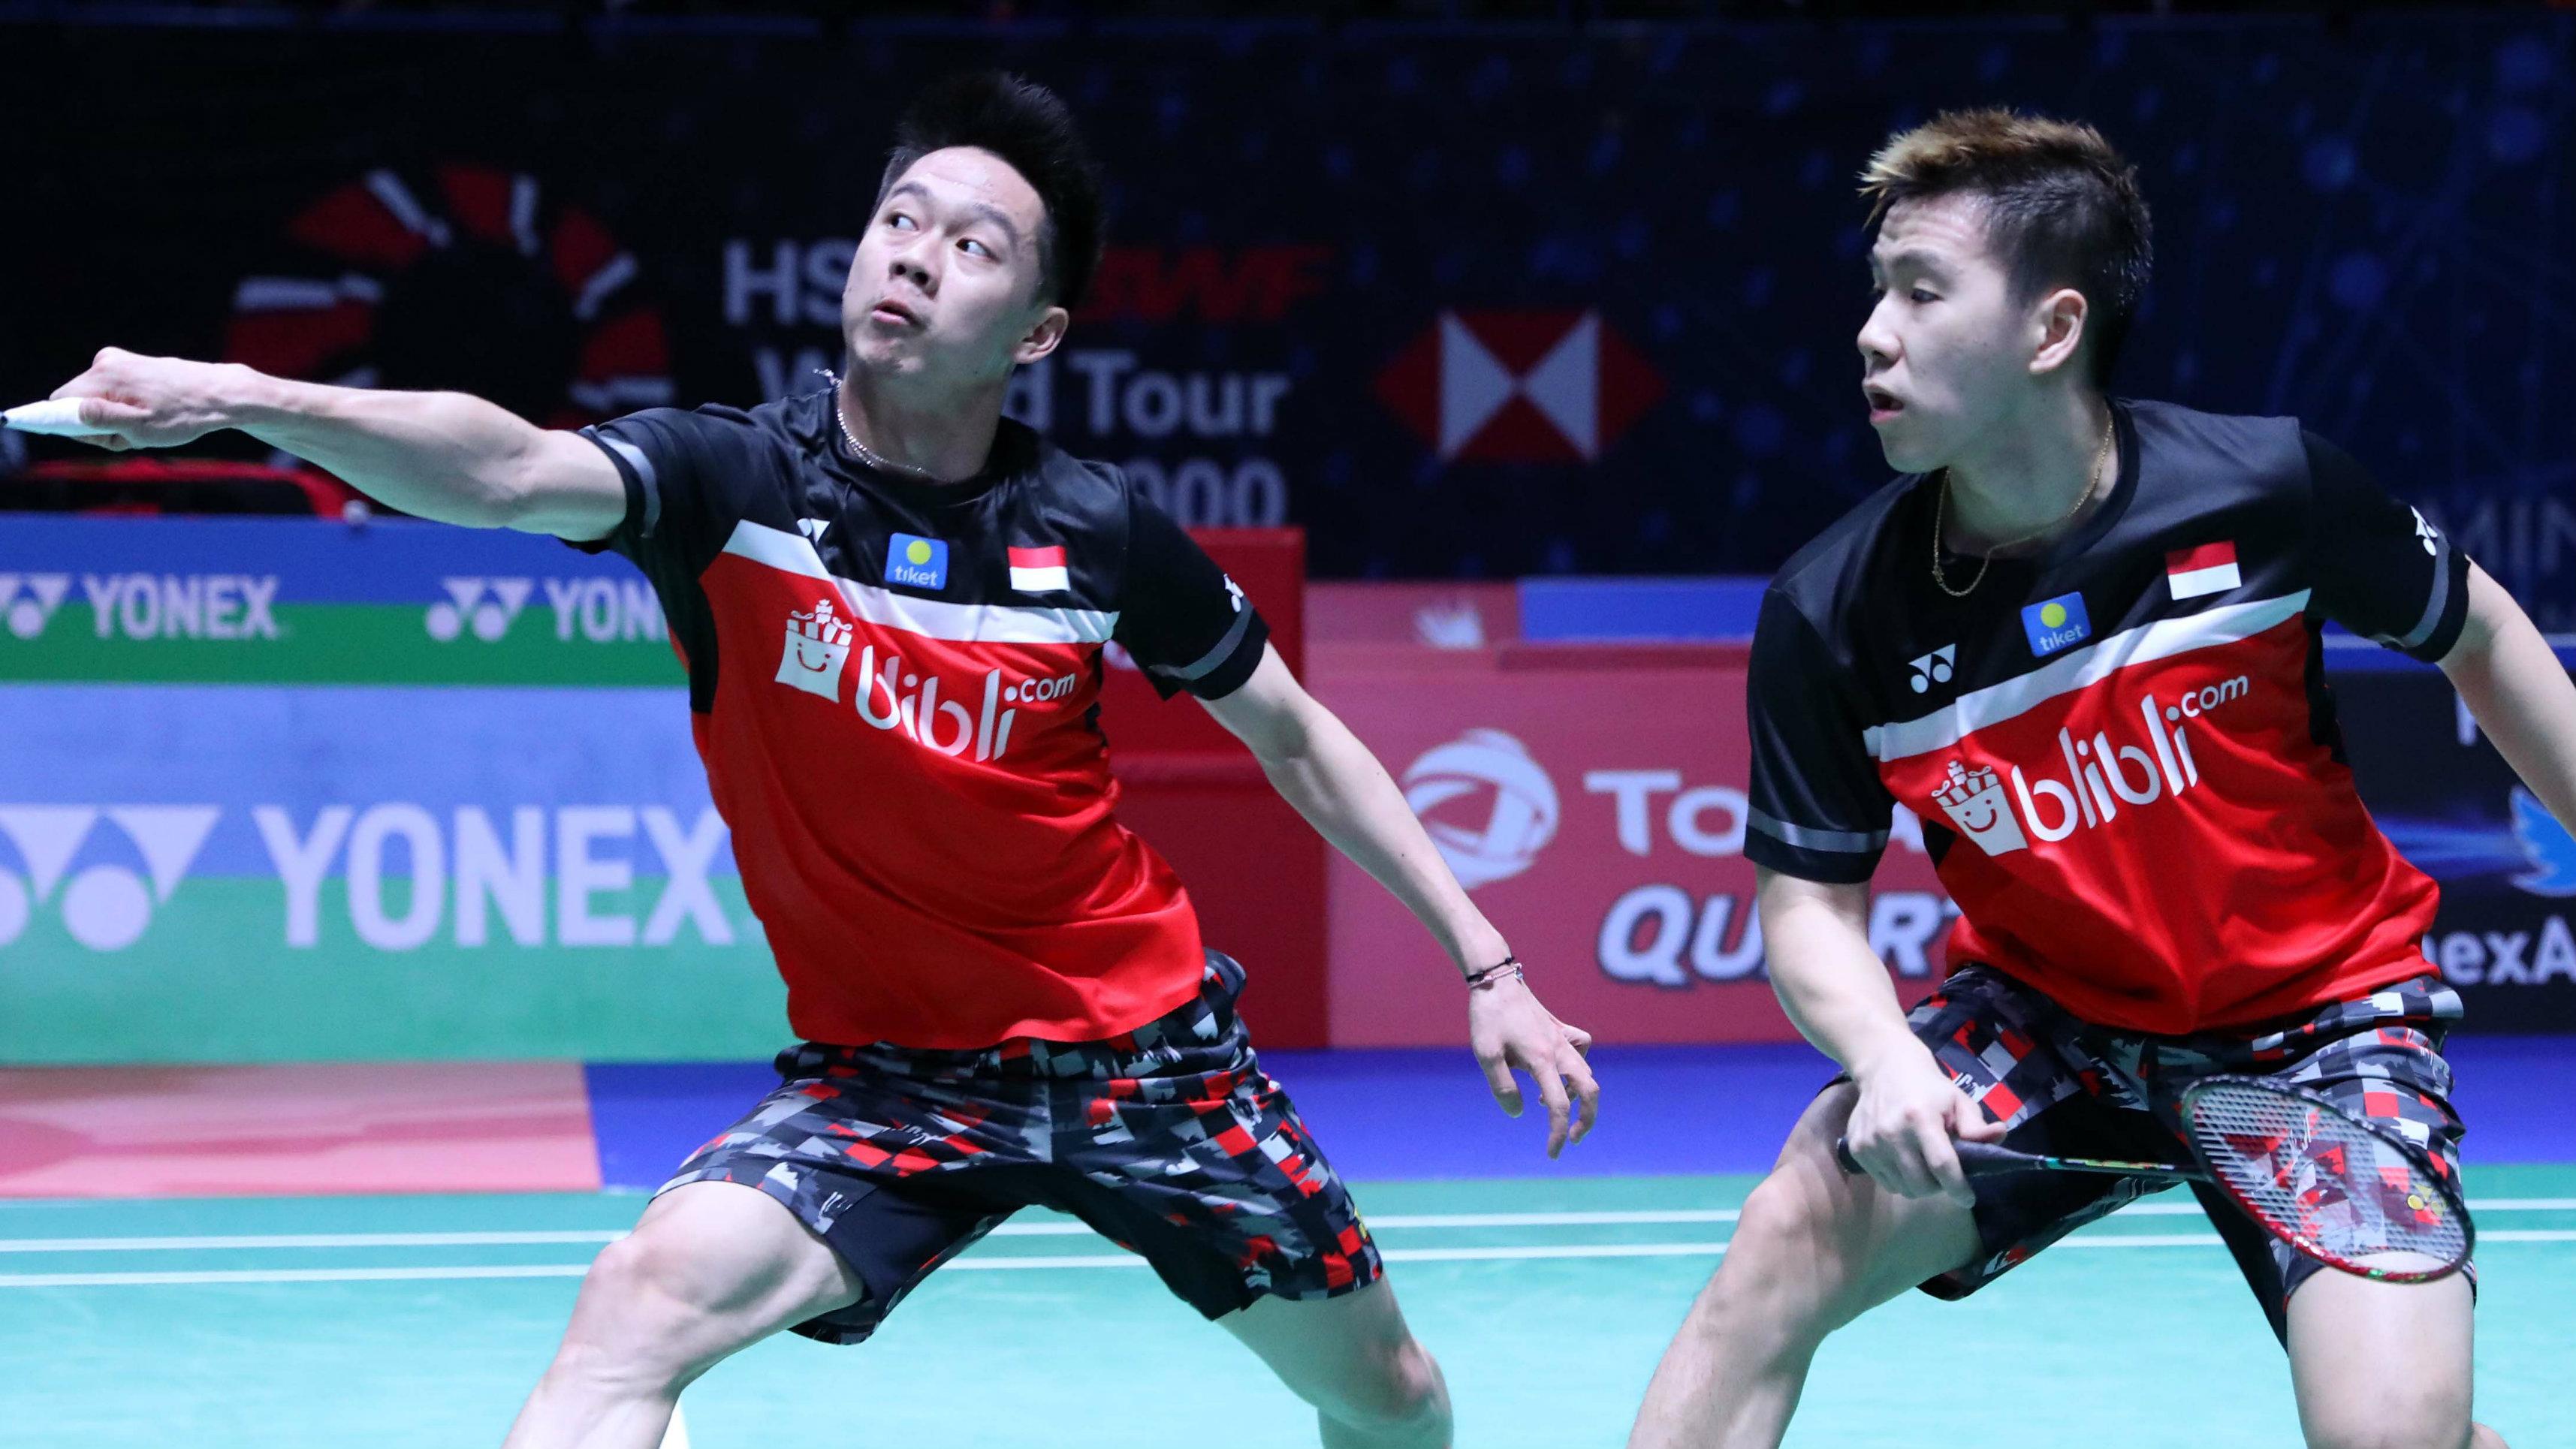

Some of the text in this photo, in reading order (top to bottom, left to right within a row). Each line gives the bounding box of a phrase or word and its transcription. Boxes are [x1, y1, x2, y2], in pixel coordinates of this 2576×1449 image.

[1064, 348, 1290, 437] Tour
[82, 575, 279, 639] YONEX
[894, 566, 939, 587] tiket
[544, 577, 665, 642] YON
[2039, 624, 2085, 652] tiket
[252, 803, 734, 951] YONEX
